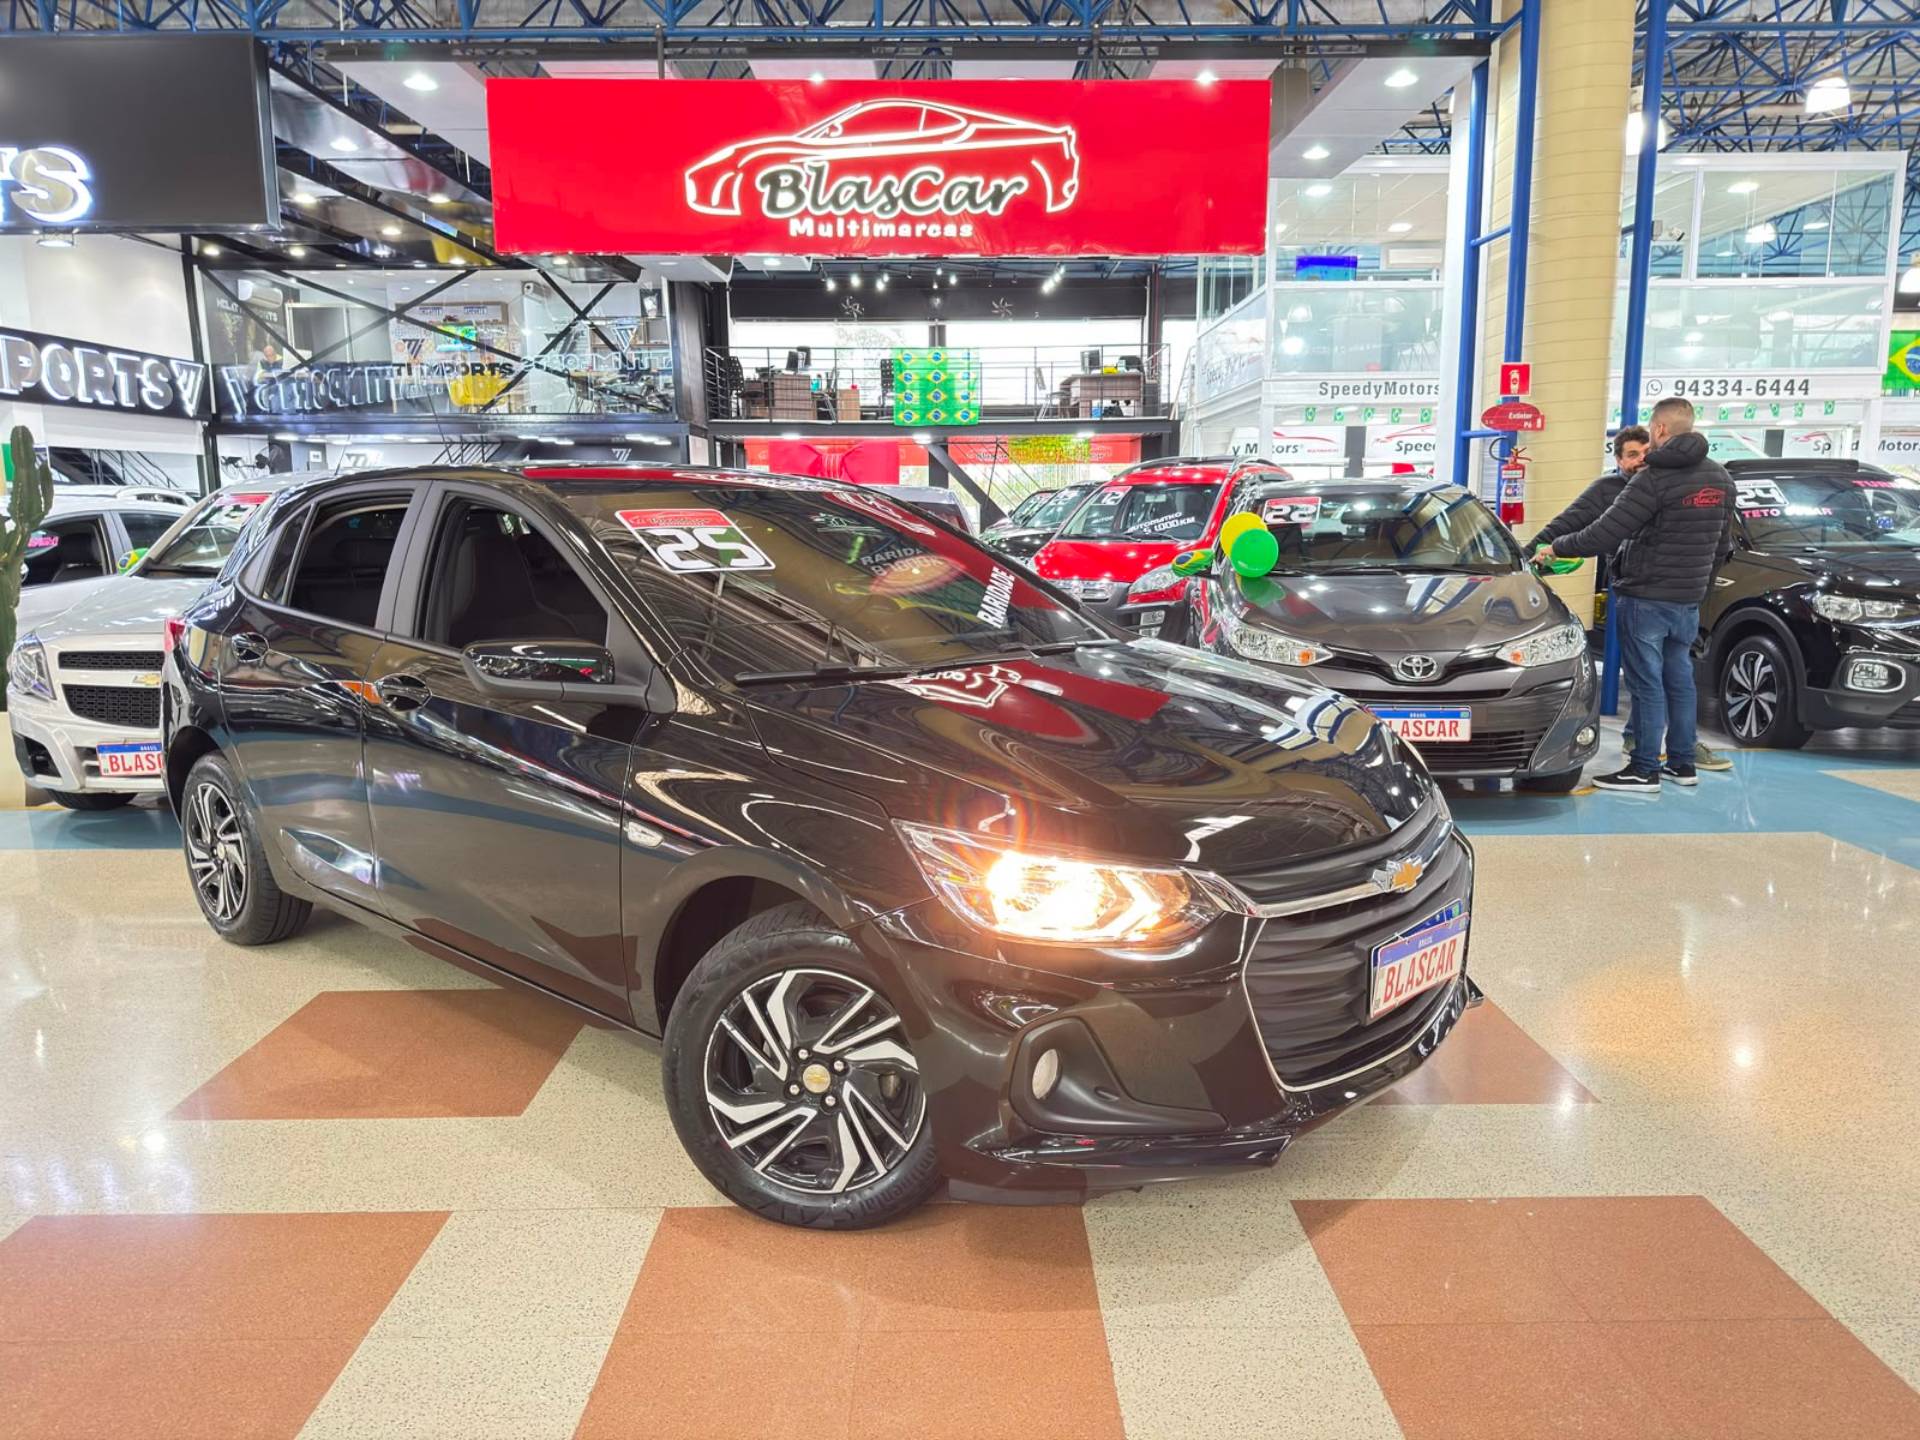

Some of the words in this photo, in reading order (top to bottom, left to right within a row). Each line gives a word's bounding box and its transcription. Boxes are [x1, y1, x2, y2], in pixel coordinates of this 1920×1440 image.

[756, 160, 1029, 219] BlasCar
[789, 217, 974, 238] Multimarcas
[1319, 381, 1439, 399] SpeedyMotors
[1674, 378, 1810, 397] 94334-6444
[1736, 487, 1785, 506] 24
[1265, 504, 1317, 524] 22
[1742, 508, 1781, 518] TETO
[646, 527, 766, 569] 25
[977, 566, 1015, 629] RARIDADE
[1384, 939, 1457, 1003] BLASCAR
